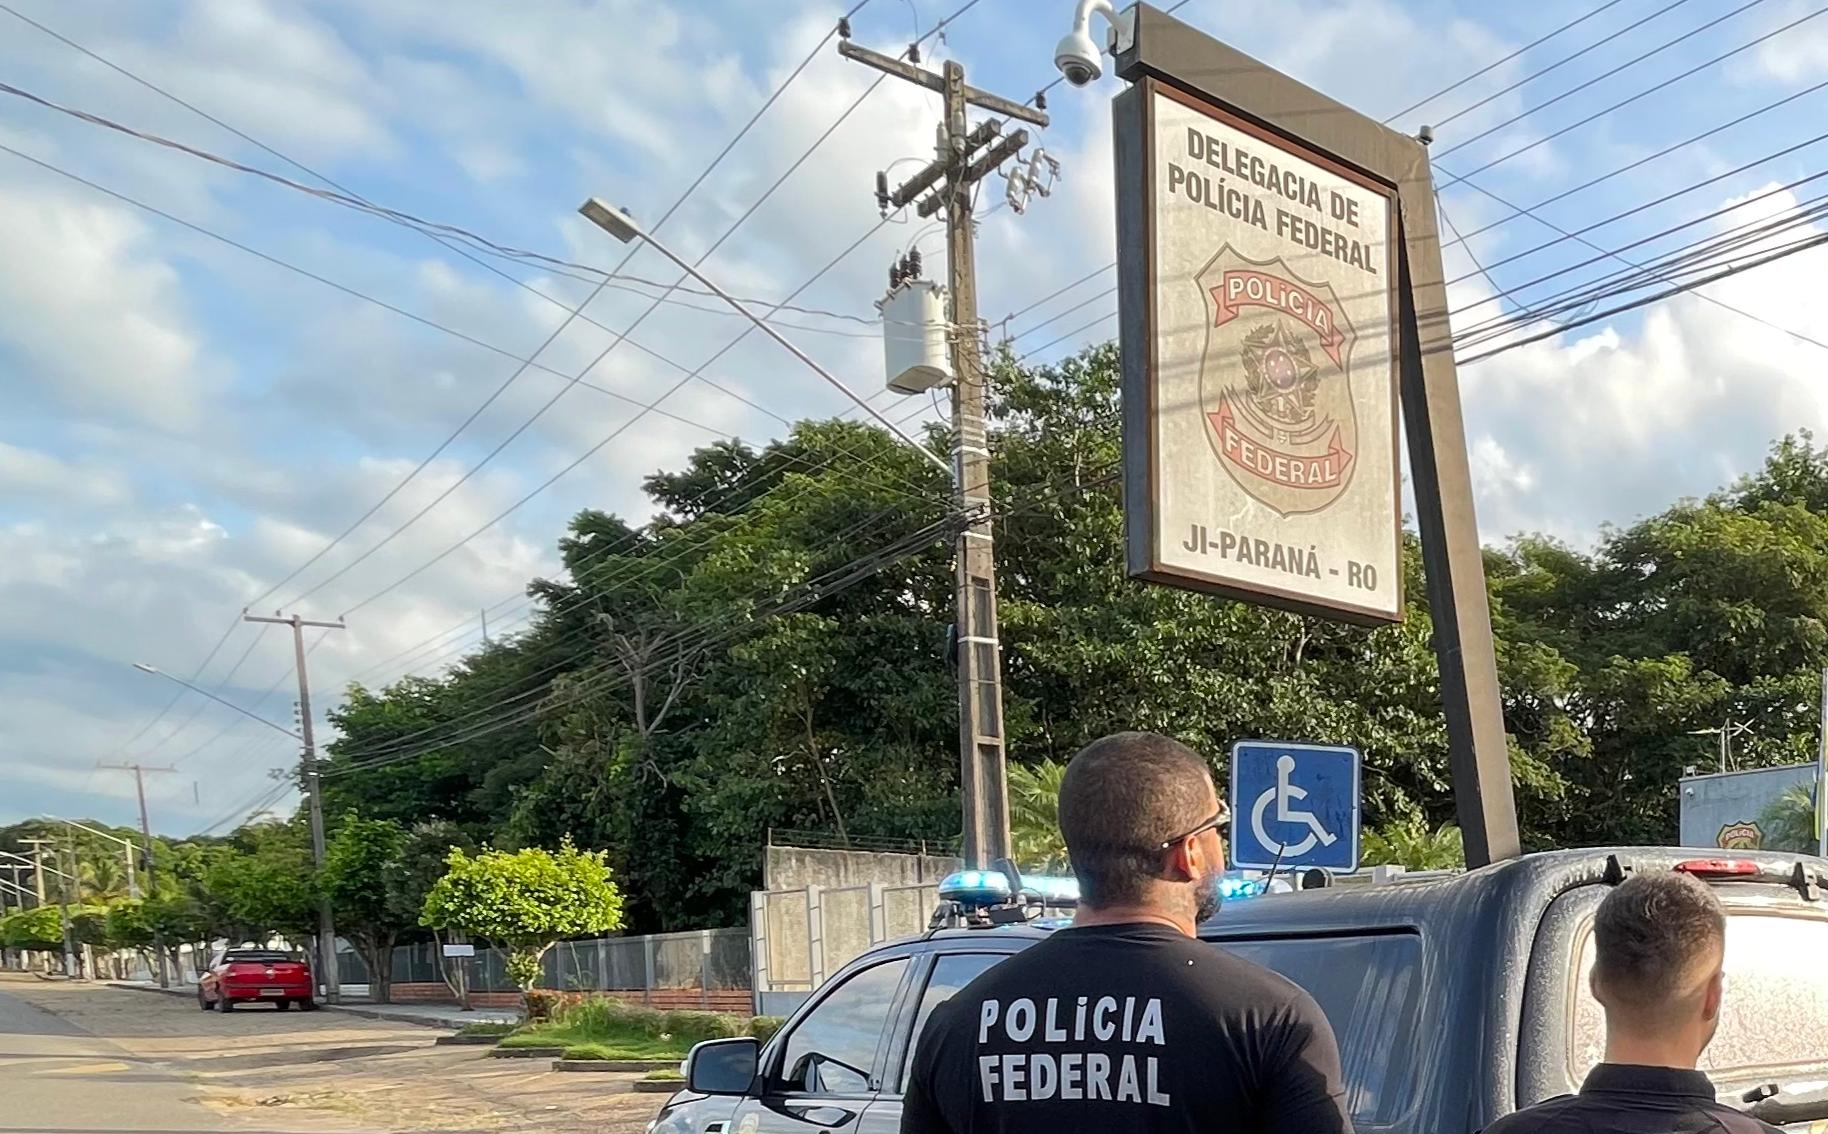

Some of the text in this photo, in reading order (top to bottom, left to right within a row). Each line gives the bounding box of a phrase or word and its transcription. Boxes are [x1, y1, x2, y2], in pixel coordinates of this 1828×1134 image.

[1188, 127, 1359, 228] DELEGACIA DE
[1168, 162, 1377, 275] POLÍCIA FEDERAL
[1224, 431, 1337, 485] FEDERAL
[1183, 524, 1321, 580] JI-PARANÁ
[1347, 560, 1377, 592] RO
[978, 1053, 1171, 1107] FEDERAL
